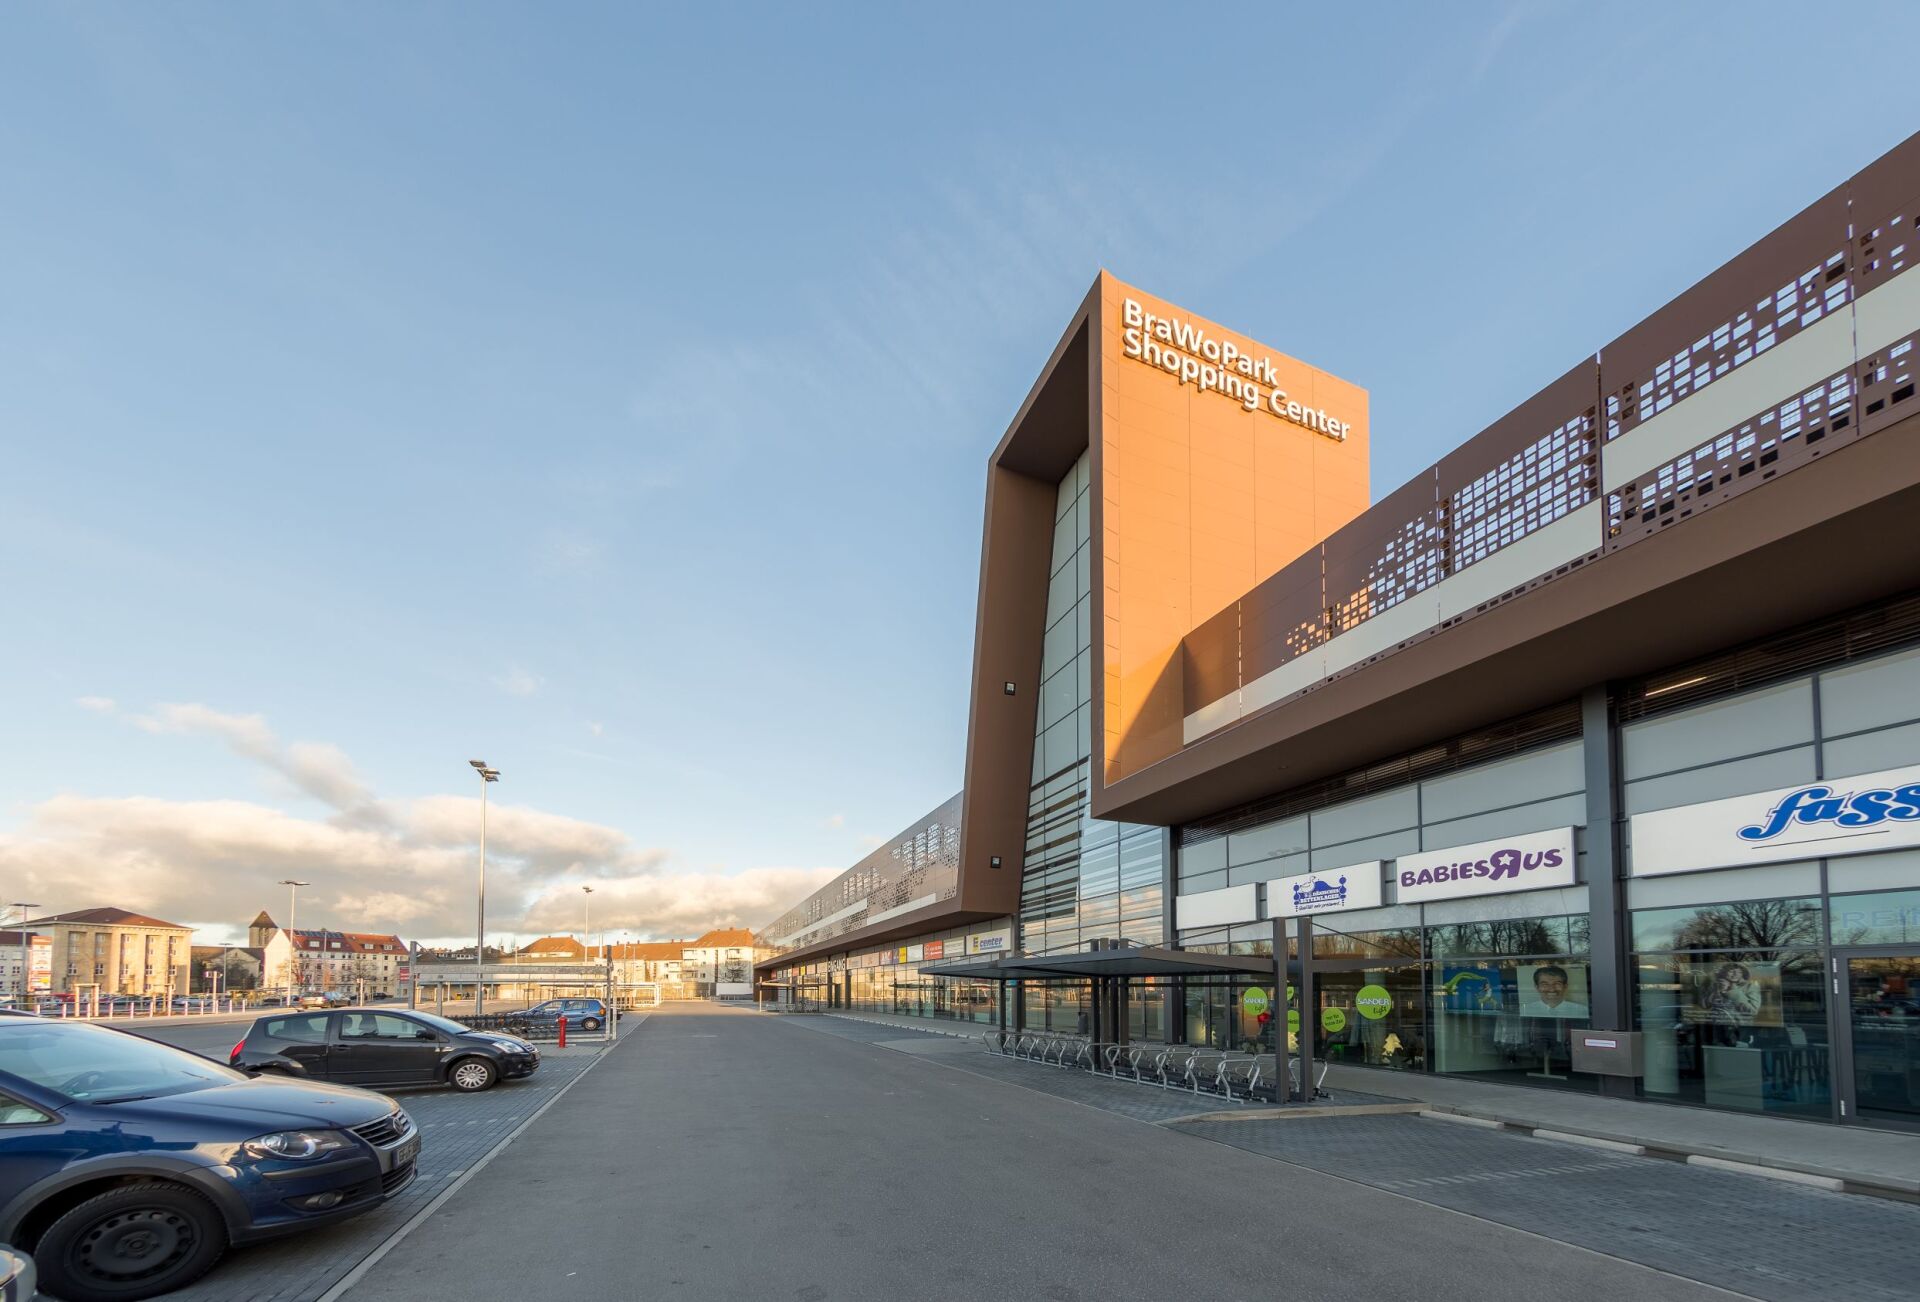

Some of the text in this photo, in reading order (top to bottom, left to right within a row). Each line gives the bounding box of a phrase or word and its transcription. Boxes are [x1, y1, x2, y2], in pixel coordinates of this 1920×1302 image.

[1123, 297, 1279, 389] BraWoPark
[1123, 328, 1351, 442] Shopping Center
[1357, 998, 1390, 1006] SANDER
